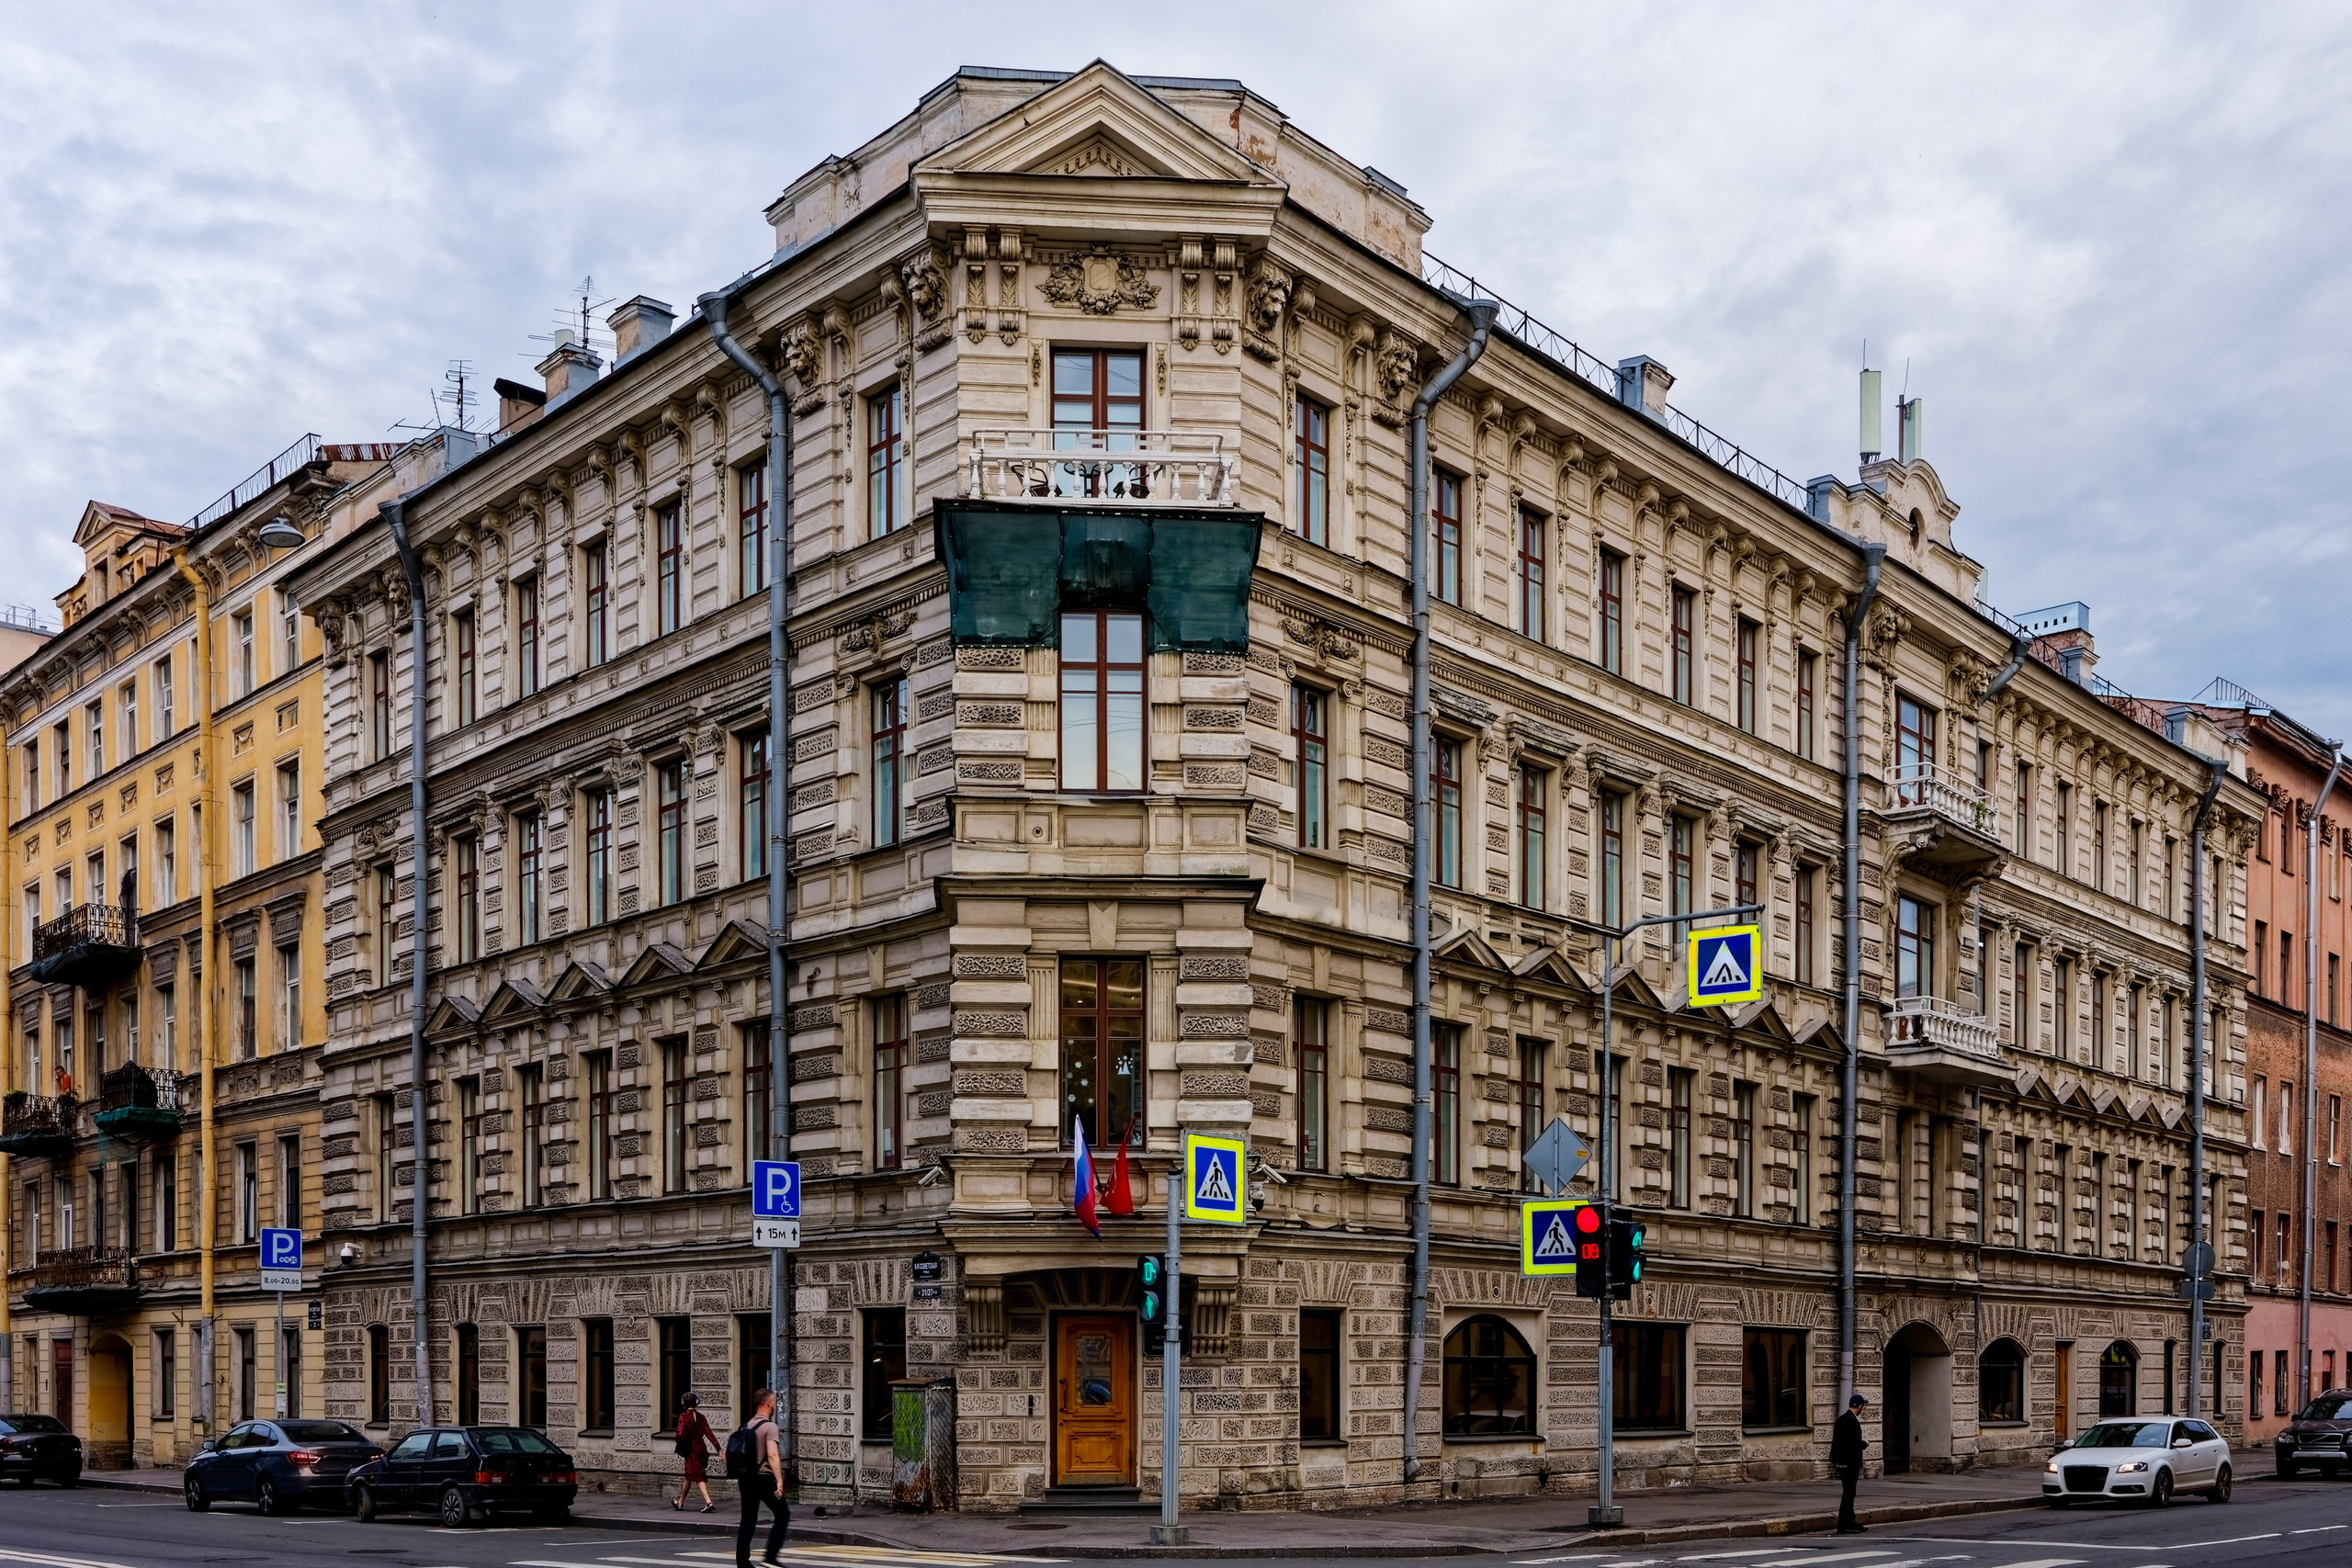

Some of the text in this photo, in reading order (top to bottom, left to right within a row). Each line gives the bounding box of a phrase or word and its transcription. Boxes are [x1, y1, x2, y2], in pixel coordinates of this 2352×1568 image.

[767, 1168, 792, 1210] P
[272, 1233, 294, 1264] P
[1581, 1243, 1600, 1259] 08
[264, 1276, 300, 1285] 8.00-20.00
